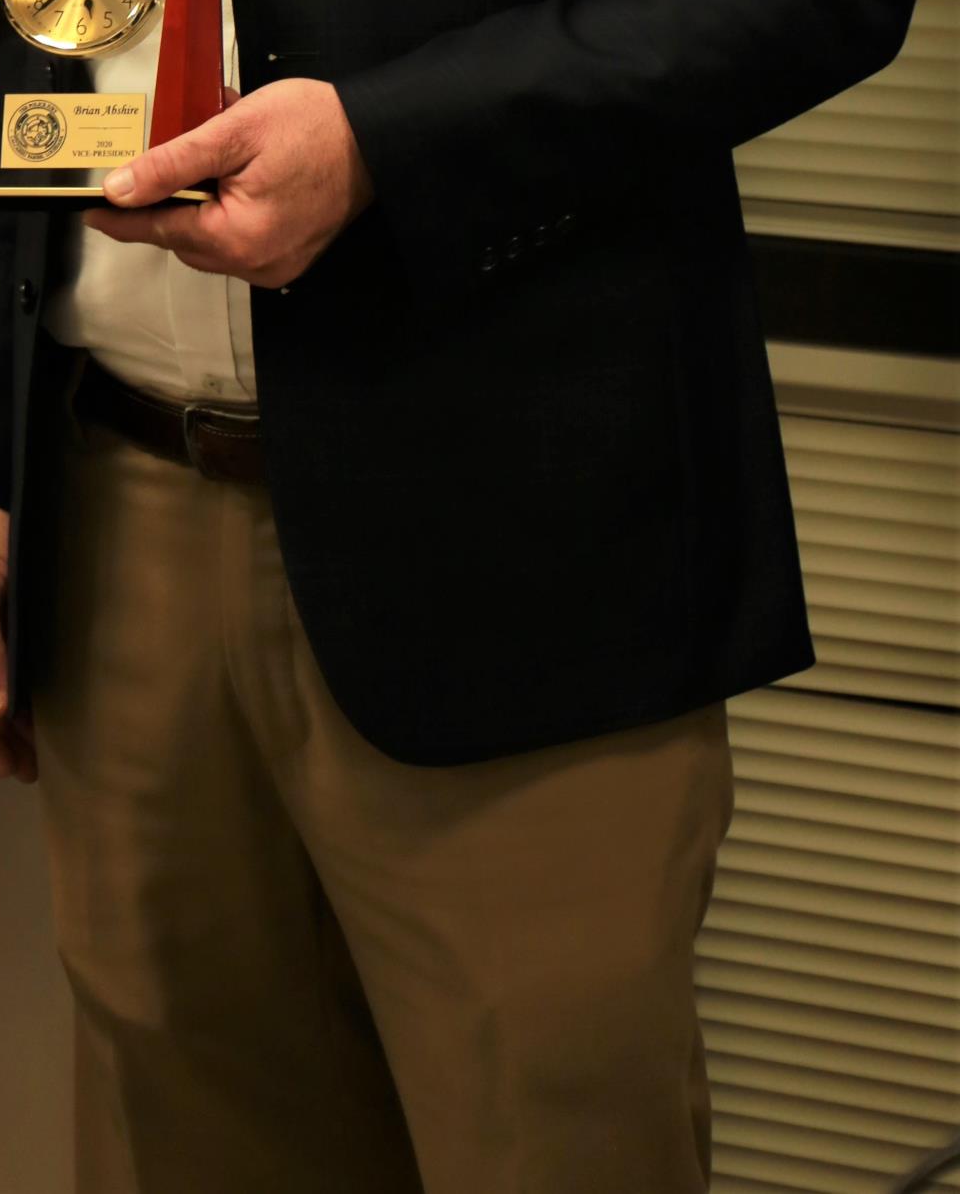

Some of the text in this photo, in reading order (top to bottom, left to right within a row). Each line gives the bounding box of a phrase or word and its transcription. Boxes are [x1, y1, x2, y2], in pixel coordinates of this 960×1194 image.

[53, 10, 65, 28] 7
[76, 17, 88, 36] 6
[103, 11, 114, 29] 5
[73, 104, 140, 117] Brian Abshire
[96, 140, 113, 149] 2020
[71, 149, 137, 158] VICE-PRESIDENT
